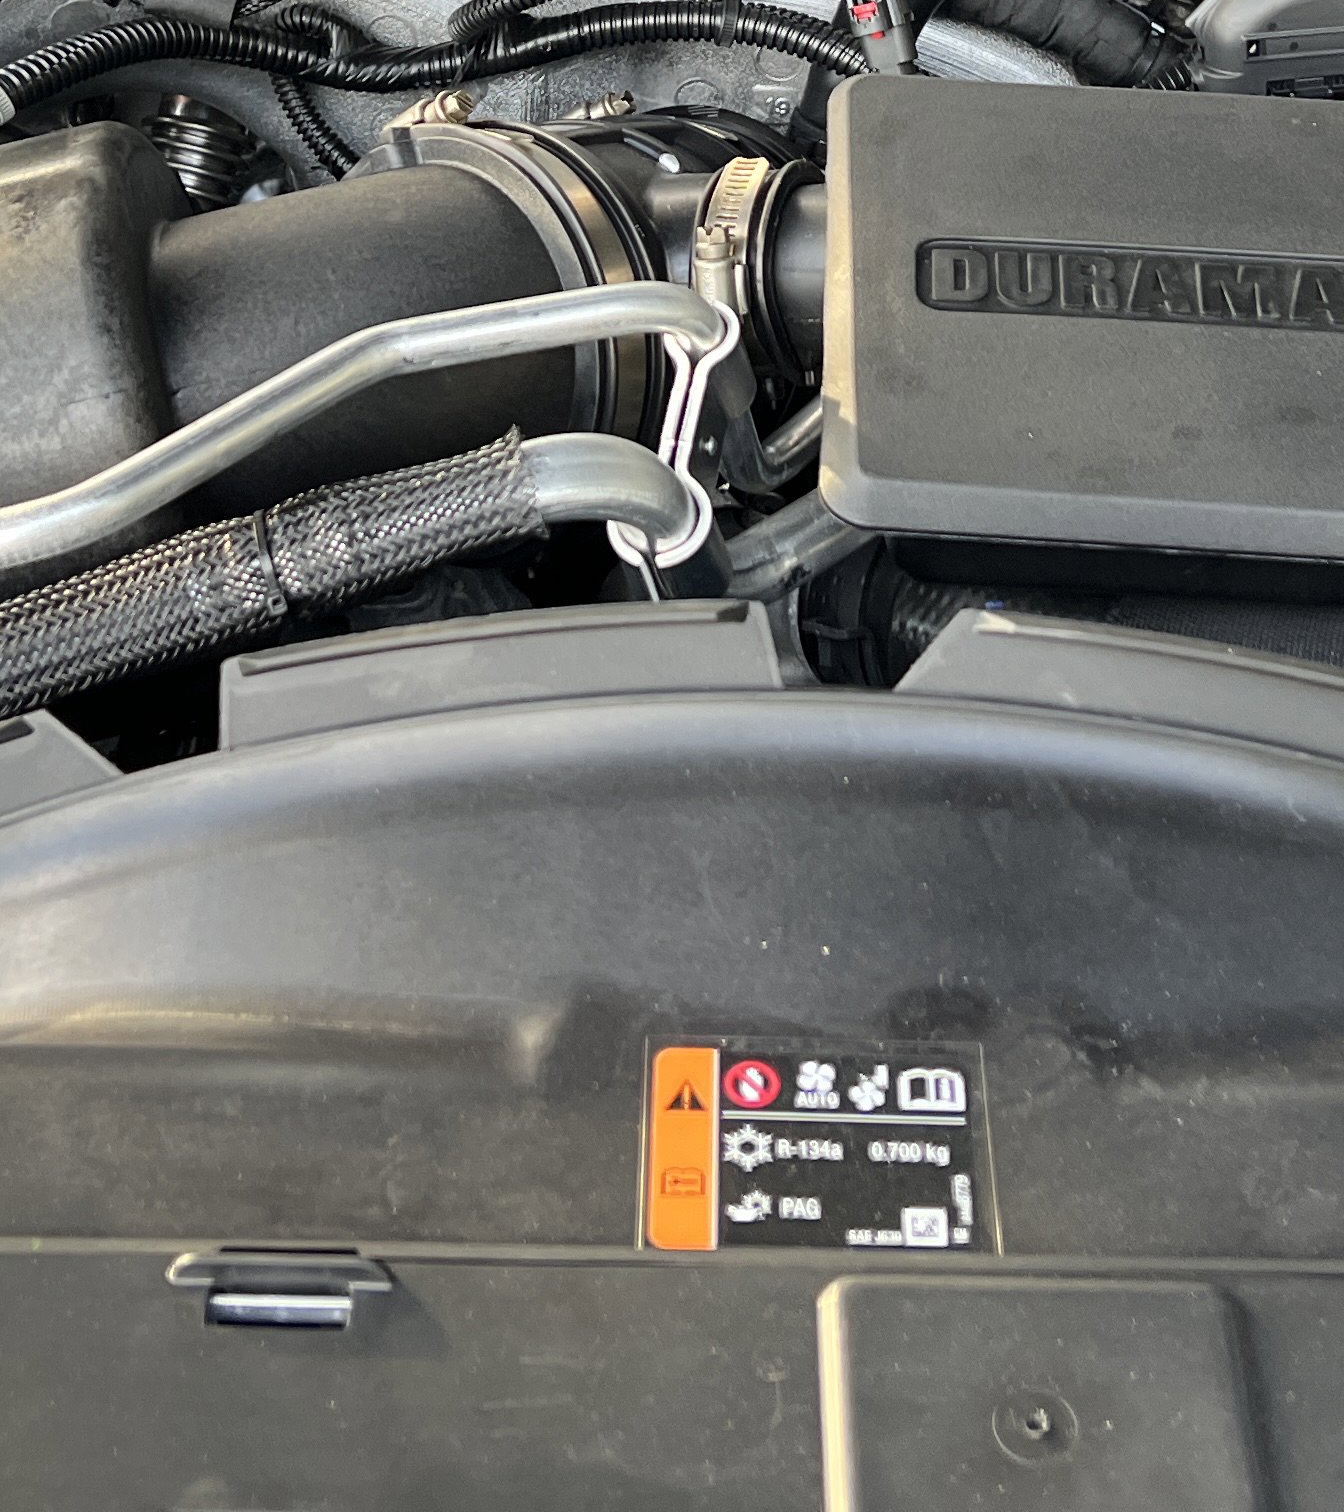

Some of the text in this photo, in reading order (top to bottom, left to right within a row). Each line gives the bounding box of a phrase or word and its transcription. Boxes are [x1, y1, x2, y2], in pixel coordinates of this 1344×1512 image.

[794, 1091, 840, 1109] AUTO
[775, 1138, 951, 1167] R-134a 0.700 kg
[779, 1196, 823, 1220] PAG
